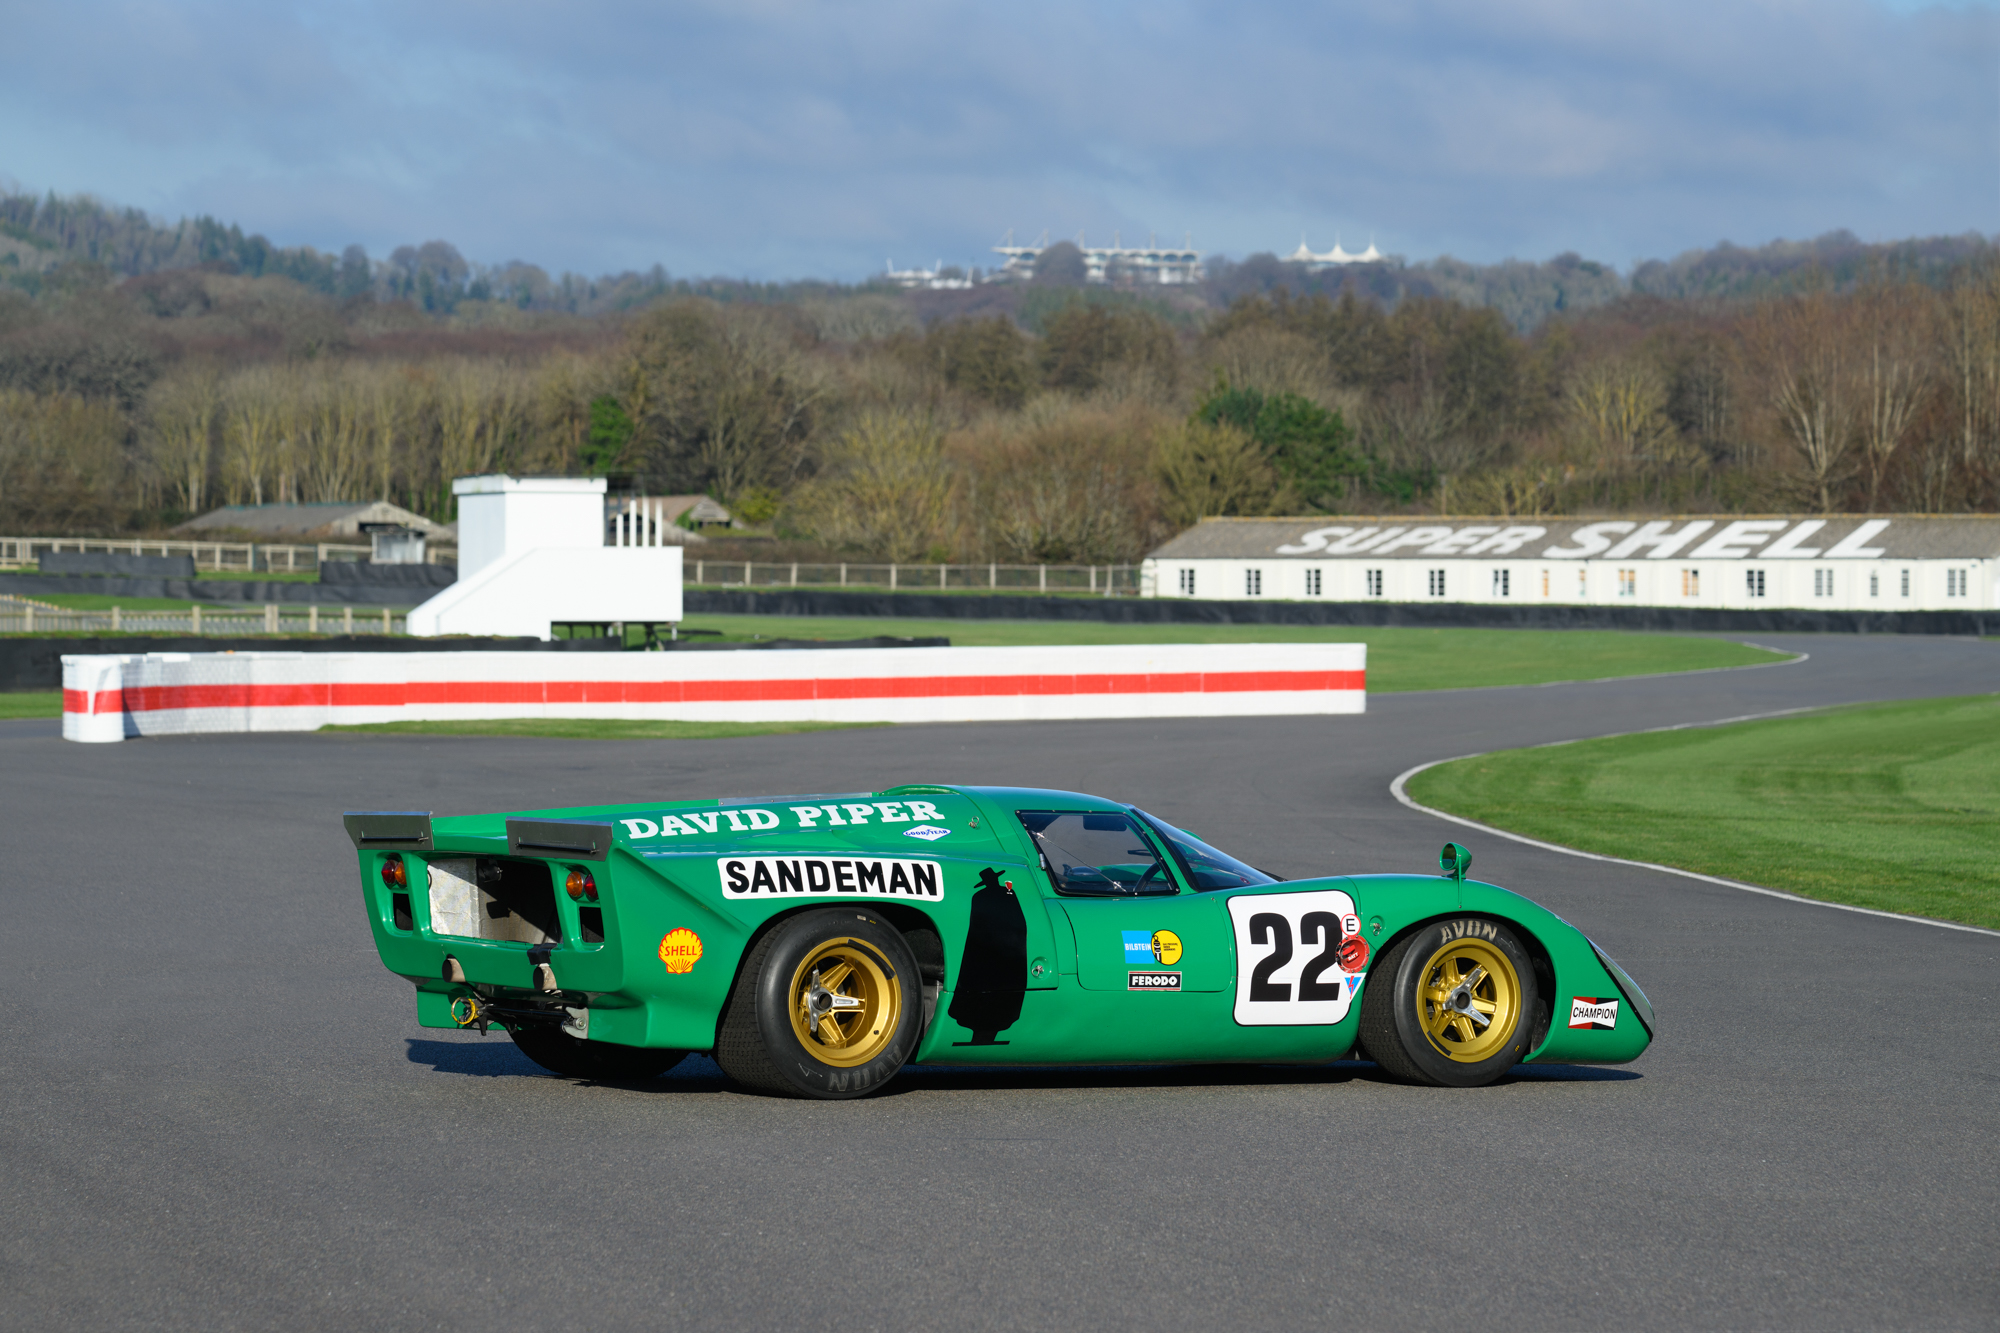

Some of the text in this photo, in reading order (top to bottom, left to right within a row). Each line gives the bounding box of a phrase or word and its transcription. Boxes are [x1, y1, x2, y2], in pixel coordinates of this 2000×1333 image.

[1277, 519, 1891, 558] SUPER SHELL
[620, 801, 945, 839] DAVID PIPER
[727, 860, 938, 896] SANDEMAN
[1346, 918, 1356, 932] E
[1440, 920, 1498, 944] AVON
[664, 944, 698, 958] SHELL
[1124, 942, 1151, 952] BILSTEIN
[1249, 911, 1342, 1002] 22
[1131, 975, 1178, 987] FERODO
[1572, 1006, 1616, 1020] CHAMPION
